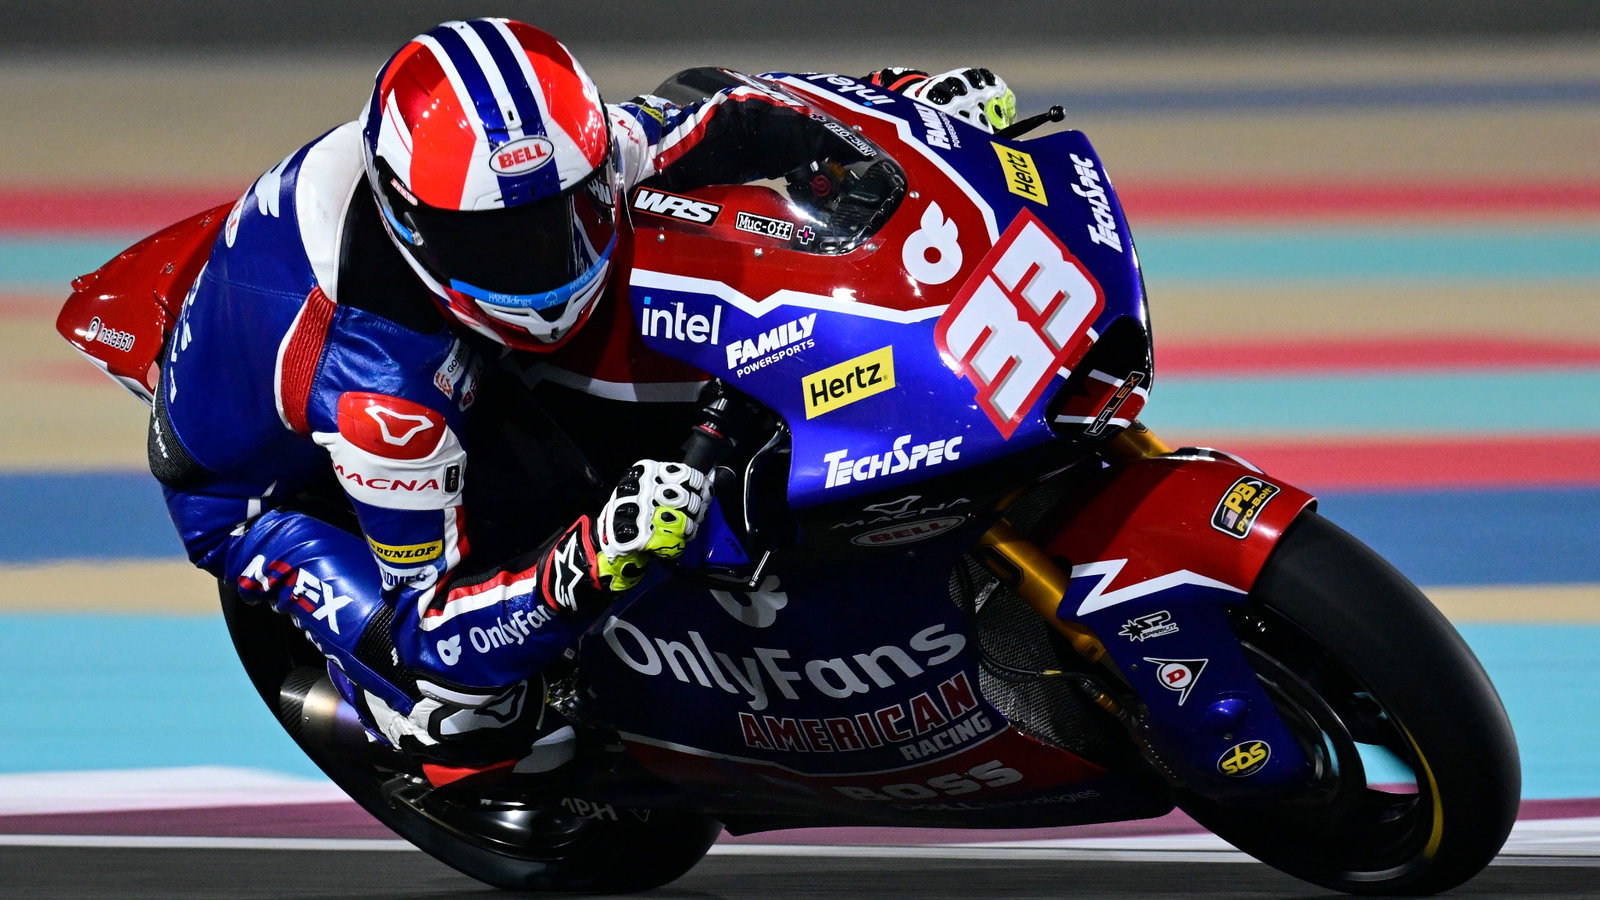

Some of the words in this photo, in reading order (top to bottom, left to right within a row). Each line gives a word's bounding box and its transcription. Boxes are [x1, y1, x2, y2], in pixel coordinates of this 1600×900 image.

[806, 73, 896, 107] intel
[497, 143, 547, 169] BELL
[1005, 151, 1038, 197] Hertz
[633, 189, 720, 223] WRS
[738, 215, 792, 239] Muc-Off
[641, 296, 722, 345] intel
[725, 312, 817, 370] FAMILY
[945, 218, 1098, 424] 33
[736, 338, 816, 379] POWERSPORTS
[810, 362, 883, 407] Hertz
[1088, 375, 1141, 434] KALEX
[331, 463, 440, 491] MACNA
[1223, 482, 1257, 514] PB
[1236, 486, 1273, 533] Pro-Bolt
[375, 544, 438, 559] DUNLOP
[868, 522, 951, 543] BELL
[603, 614, 967, 712] OnlyFans
[1166, 668, 1186, 684] D
[738, 670, 979, 753] AMERICAN
[900, 710, 994, 762] RACING
[1221, 741, 1267, 775] sbs
[832, 759, 1025, 801] BOSS
